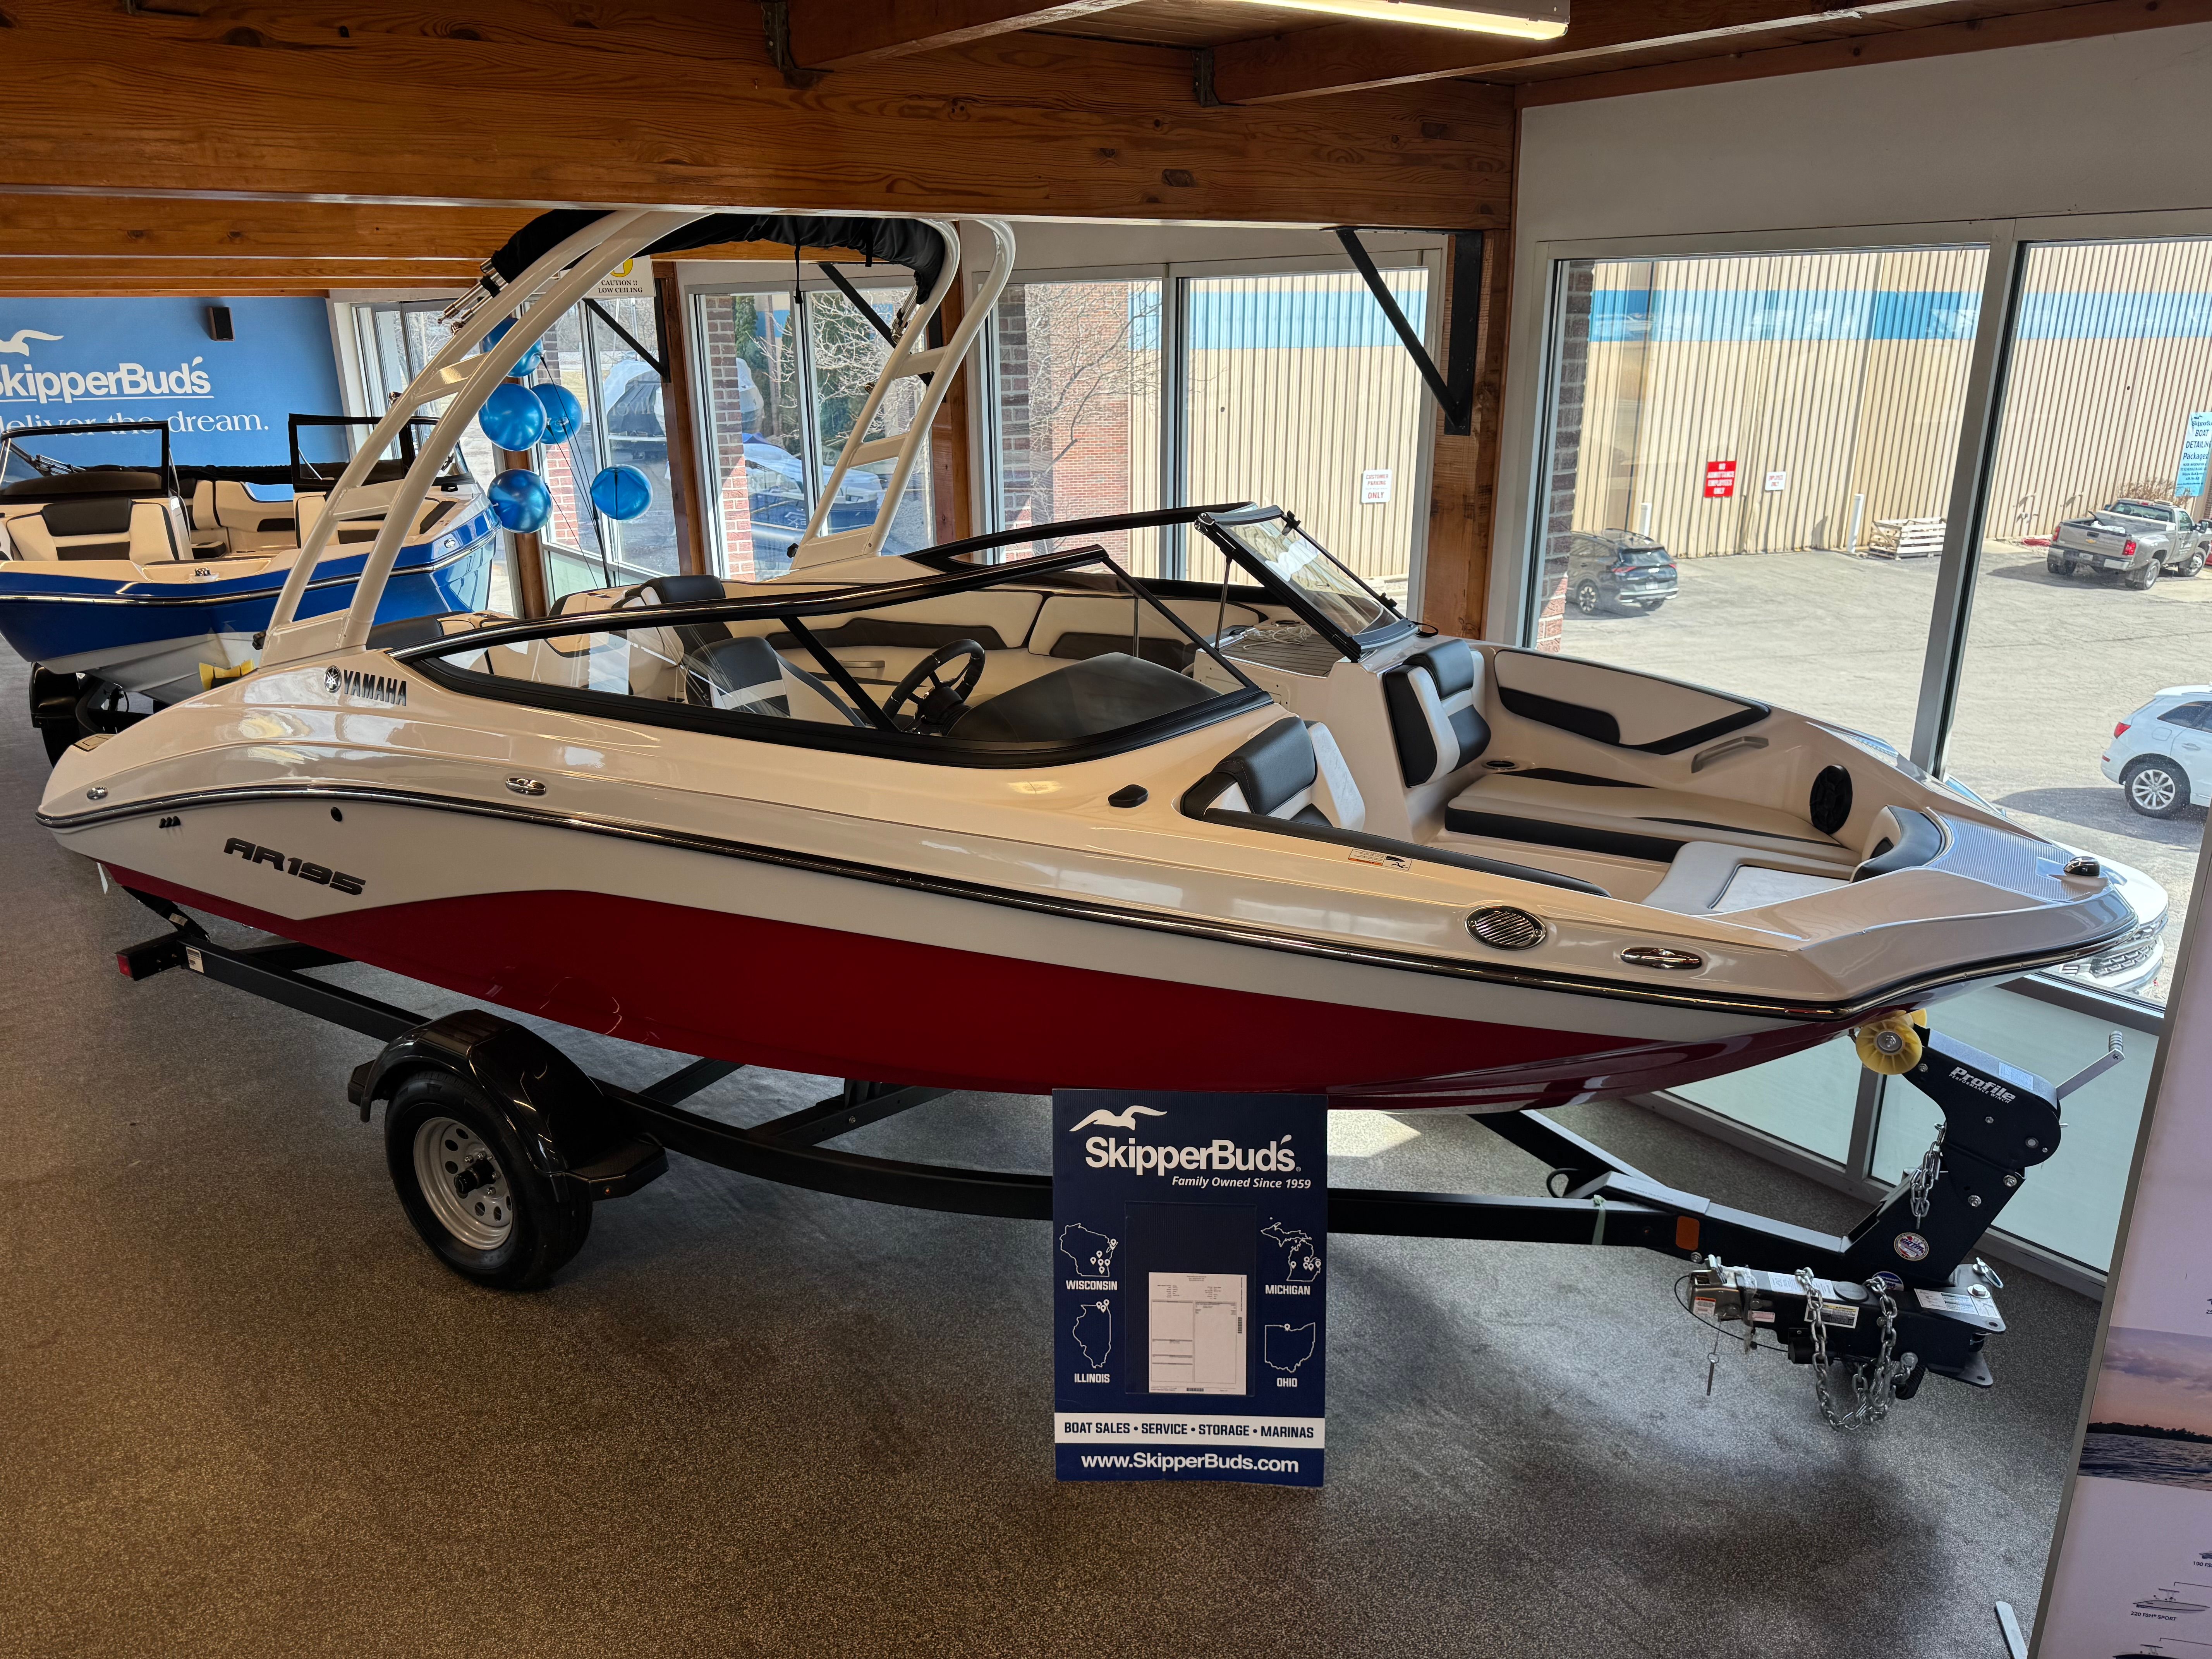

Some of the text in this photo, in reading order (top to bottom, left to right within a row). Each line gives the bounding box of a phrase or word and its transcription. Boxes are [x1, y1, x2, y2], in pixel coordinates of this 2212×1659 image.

[0, 356, 211, 404] kipperBud's
[169, 411, 268, 432] dream.
[2183, 452, 2209, 461] Packages
[343, 669, 406, 706] YAMAHA
[223, 838, 366, 895] AR195
[1948, 1073, 1989, 1094] PERFORMANCE
[1990, 1092, 2010, 1104] WINCH
[1951, 1066, 2016, 1101] Profile
[1172, 1176, 1311, 1189] Family Owned Since 1959
[1066, 1279, 1118, 1291] WISCONSIN
[1265, 1284, 1310, 1296] MICHIGAN
[1074, 1373, 1110, 1384] ILLINOIS
[1276, 1377, 1298, 1388] OHIO
[1064, 1422, 1314, 1438] BOAT SALES SERVICE STORAGE MARINAS
[1081, 1452, 1299, 1473] www.SkipperBuds.com
